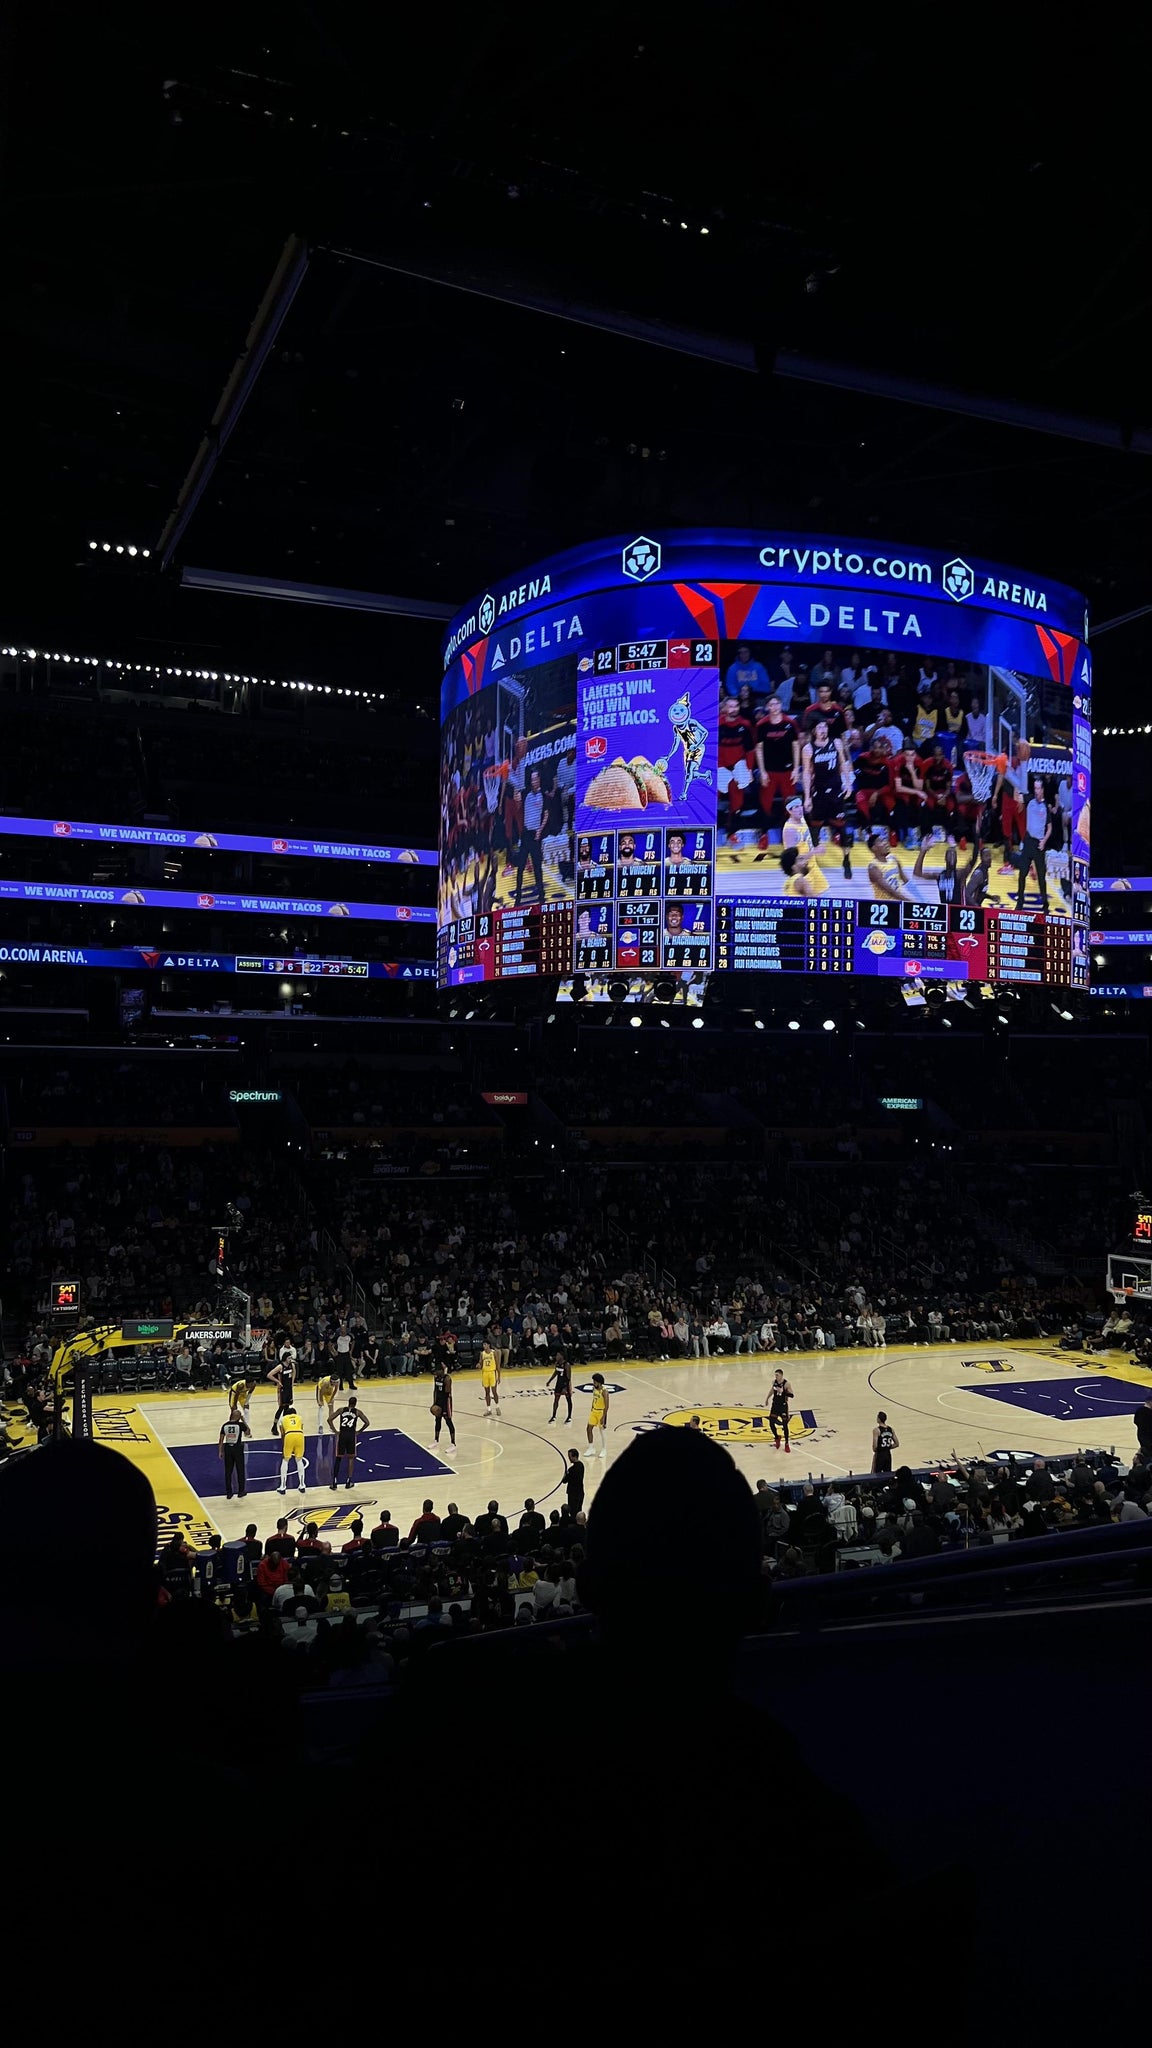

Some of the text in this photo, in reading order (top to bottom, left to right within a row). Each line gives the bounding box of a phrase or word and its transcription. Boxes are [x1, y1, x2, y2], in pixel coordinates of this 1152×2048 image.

[759, 547, 931, 583] crypto.com
[498, 575, 551, 615] ARENA
[982, 577, 1047, 612] ARENA
[810, 604, 922, 637] DELTA
[510, 615, 584, 660] DELTA
[598, 644, 712, 670] 22 5:47 23
[625, 662, 635, 670] 24
[583, 679, 655, 701] LAKERS WIN.
[583, 696, 630, 715] YOU WIN
[582, 709, 659, 731] 2 FREE TACOS.
[100, 828, 186, 843] WE WANT TACOS
[600, 837, 608, 852] 4
[644, 833, 655, 860] 0 PTS
[694, 832, 706, 859] 5 PTS
[313, 844, 391, 859] WE WANT TACOS
[629, 865, 656, 876] VINCENT
[669, 864, 708, 875] M. CHRISTIE
[651, 877, 656, 888] 1
[669, 876, 707, 888] 0 1 0
[24, 886, 114, 900] WE WANT TACOS
[241, 899, 322, 912] WE WANT TACOS
[807, 899, 818, 907] PTS
[600, 906, 607, 922] 3
[626, 904, 650, 915] 5:47
[721, 908, 727, 917] 3
[735, 908, 765, 917] ANTHONY
[810, 909, 815, 919] 4
[823, 910, 827, 919] 1
[835, 910, 839, 919] 1
[693, 904, 705, 930] 7 PTS
[870, 904, 889, 925] 22
[912, 905, 938, 919] 5:47
[960, 909, 975, 931] 23
[721, 920, 726, 930] 7
[751, 921, 777, 930] VINCENT
[847, 923, 851, 933] 1
[909, 921, 942, 931] 24 1ST
[642, 931, 654, 943] 22
[664, 935, 710, 946] R. HACHIMURA
[720, 933, 727, 943] 12
[735, 933, 750, 943] MAX
[750, 934, 777, 943] CHRISTIE
[809, 935, 815, 944] 5
[835, 936, 839, 945] 1
[1128, 934, 1145, 942] WE
[42, 950, 88, 963] ARENA.
[642, 950, 654, 963] 23
[668, 948, 675, 959] 0
[684, 948, 690, 959] 2
[720, 946, 727, 955] 15
[734, 946, 757, 956] AUSTIN
[809, 948, 815, 957] 3
[822, 948, 827, 958] 2
[847, 949, 851, 958] 1
[178, 958, 219, 968] DELTA
[809, 961, 814, 970] 7
[833, 961, 839, 971] 2
[310, 964, 321, 972] 22
[329, 965, 340, 973] 23
[347, 966, 367, 975] 5:47
[415, 969, 437, 977] DEL
[1090, 987, 1127, 995] DELTA
[230, 1090, 278, 1102] Spectrum
[1135, 1222, 1151, 1237] 24
[58, 1294, 73, 1304] 24
[137, 1325, 159, 1333] bibigo
[185, 1330, 232, 1340] LAKERS.COM
[342, 1417, 355, 1428] 24
[227, 1426, 235, 1434] 23
